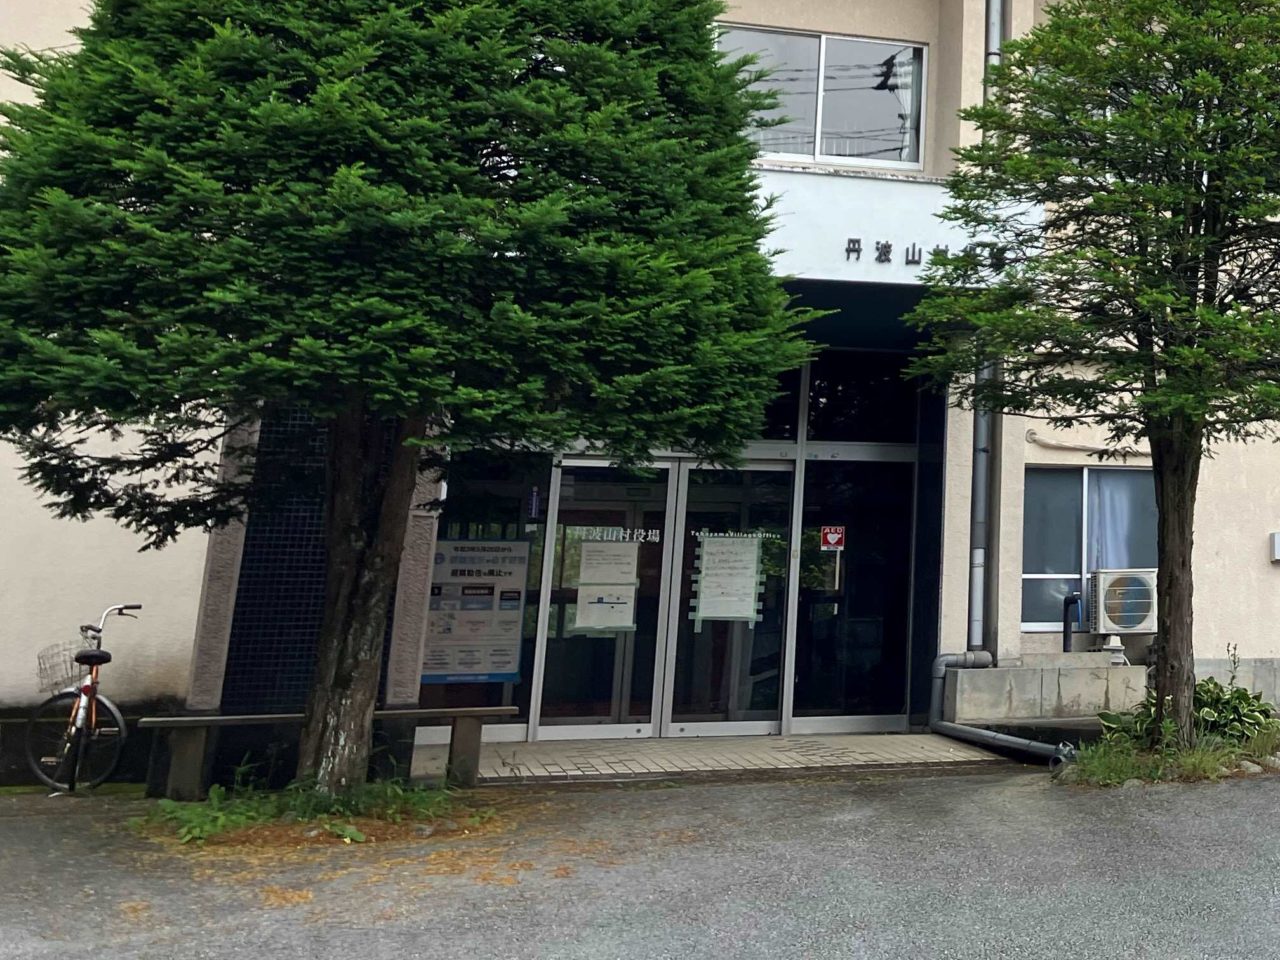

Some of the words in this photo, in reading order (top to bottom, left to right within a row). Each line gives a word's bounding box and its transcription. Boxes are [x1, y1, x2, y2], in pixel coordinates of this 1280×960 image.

[574, 527, 660, 543] 丹波山村役場
